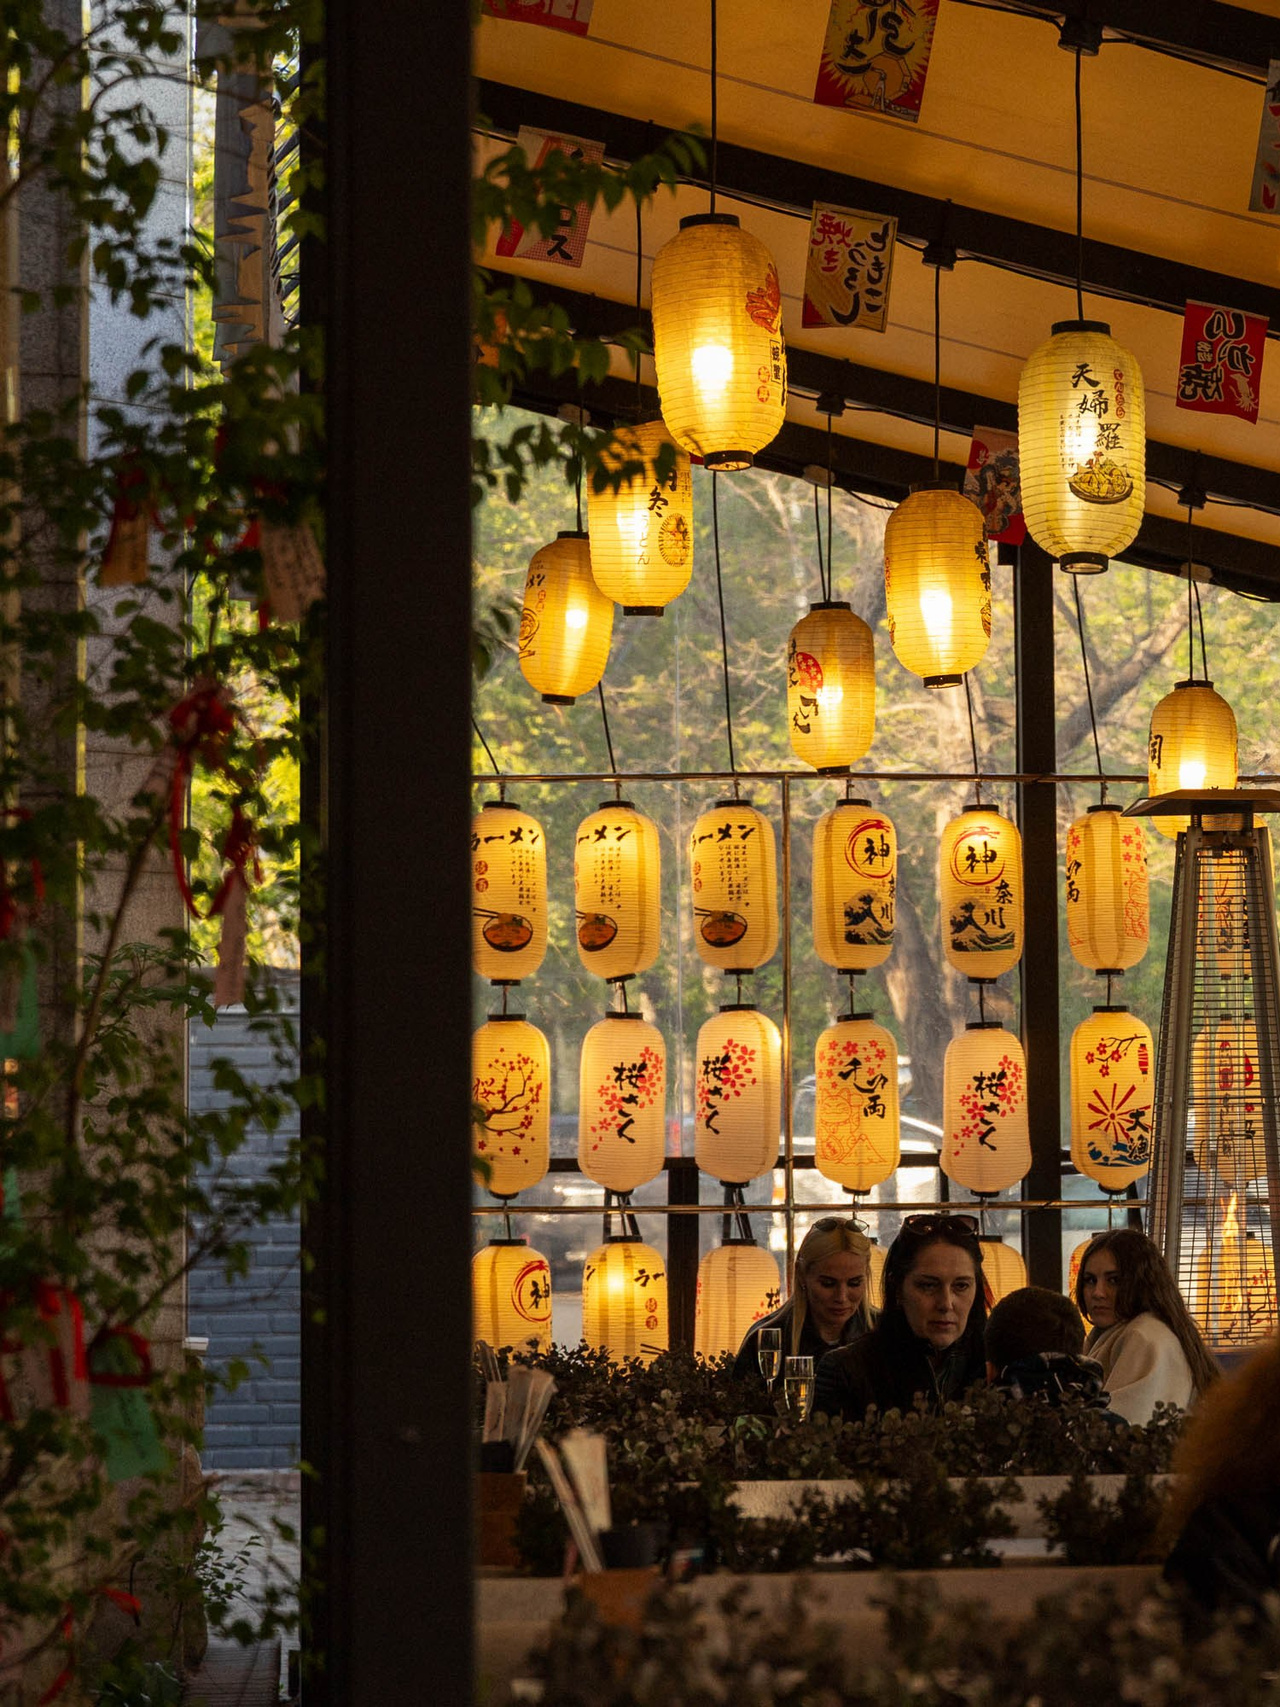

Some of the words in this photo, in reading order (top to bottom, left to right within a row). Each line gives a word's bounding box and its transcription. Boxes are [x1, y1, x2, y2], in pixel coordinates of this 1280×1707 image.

[1072, 363, 1124, 451] 天婦羅
[577, 824, 632, 844] ーメン
